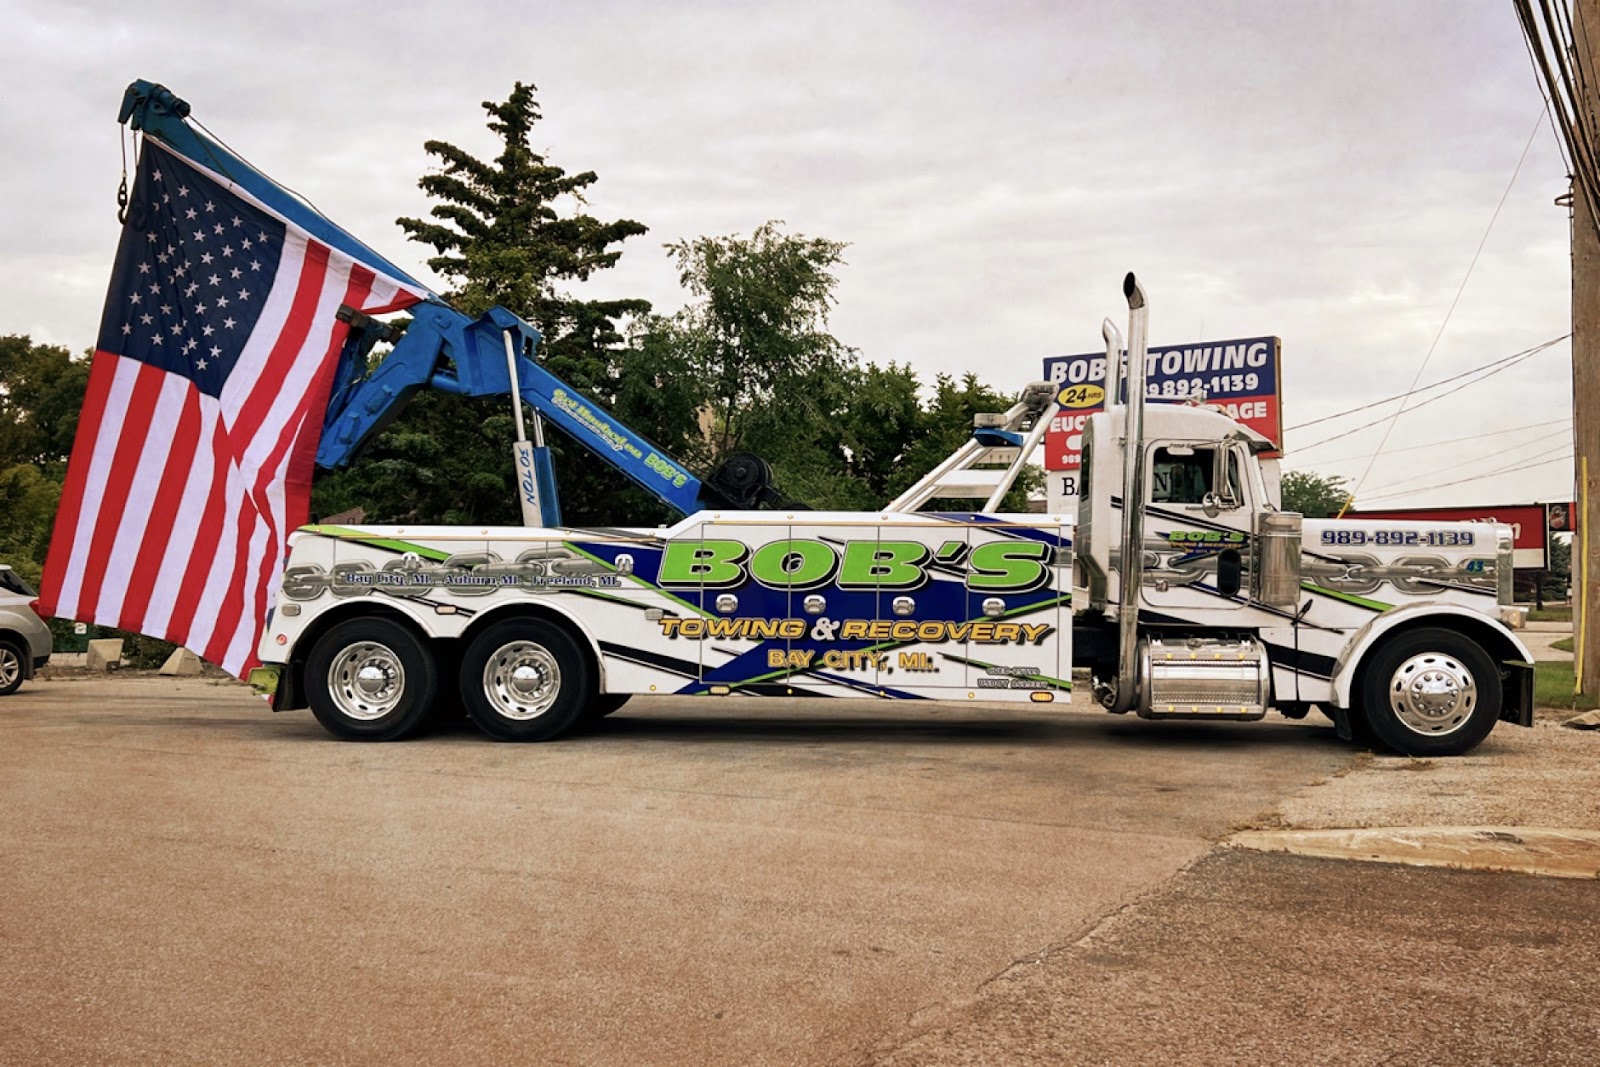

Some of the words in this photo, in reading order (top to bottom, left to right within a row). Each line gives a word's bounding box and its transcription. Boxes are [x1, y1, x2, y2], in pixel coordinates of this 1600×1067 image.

[1146, 342, 1268, 377] TOWING
[1065, 388, 1087, 404] 24
[1050, 415, 1091, 433] EUC
[517, 445, 531, 468] 30
[643, 452, 688, 489] BOB'S
[521, 469, 537, 506] TON
[1321, 530, 1475, 547] 989-892-1139
[657, 539, 1053, 594] BOB'S
[1466, 559, 1484, 572] 43
[659, 618, 806, 640] TOWING
[810, 617, 840, 641] &
[841, 619, 1051, 642] RECOVERY
[767, 649, 815, 668] BAY
[823, 650, 888, 672] CITY,
[898, 652, 935, 671] MI.
